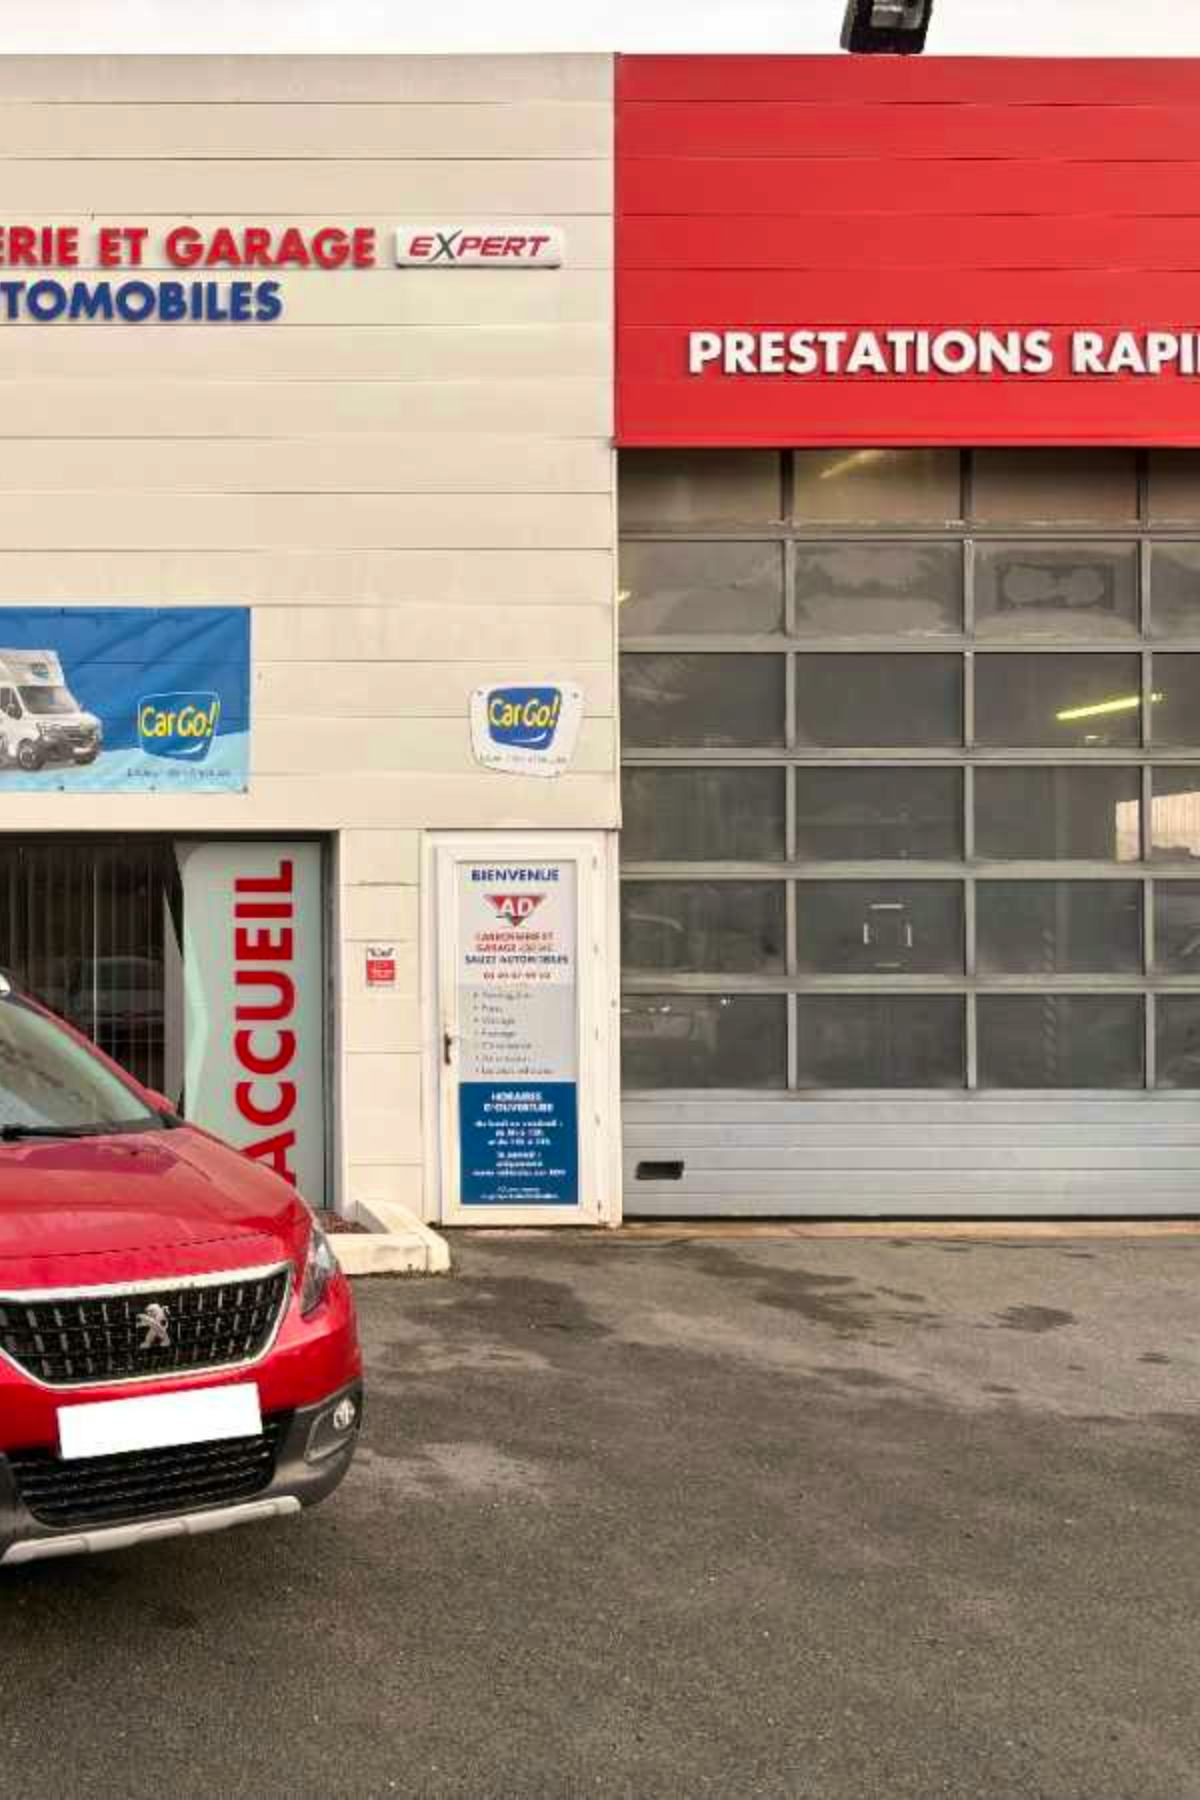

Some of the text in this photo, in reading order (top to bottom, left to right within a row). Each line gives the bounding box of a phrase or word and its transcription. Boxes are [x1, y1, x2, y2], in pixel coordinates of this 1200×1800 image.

[99, 227, 148, 267] ET
[165, 226, 376, 268] GARAGE
[408, 229, 551, 263] EXPERT
[688, 330, 1200, 374] PRESTATIONS RAPI
[471, 869, 560, 882] BIENVENUE
[500, 896, 534, 917] AD
[234, 859, 297, 1187] ACCUEIL
